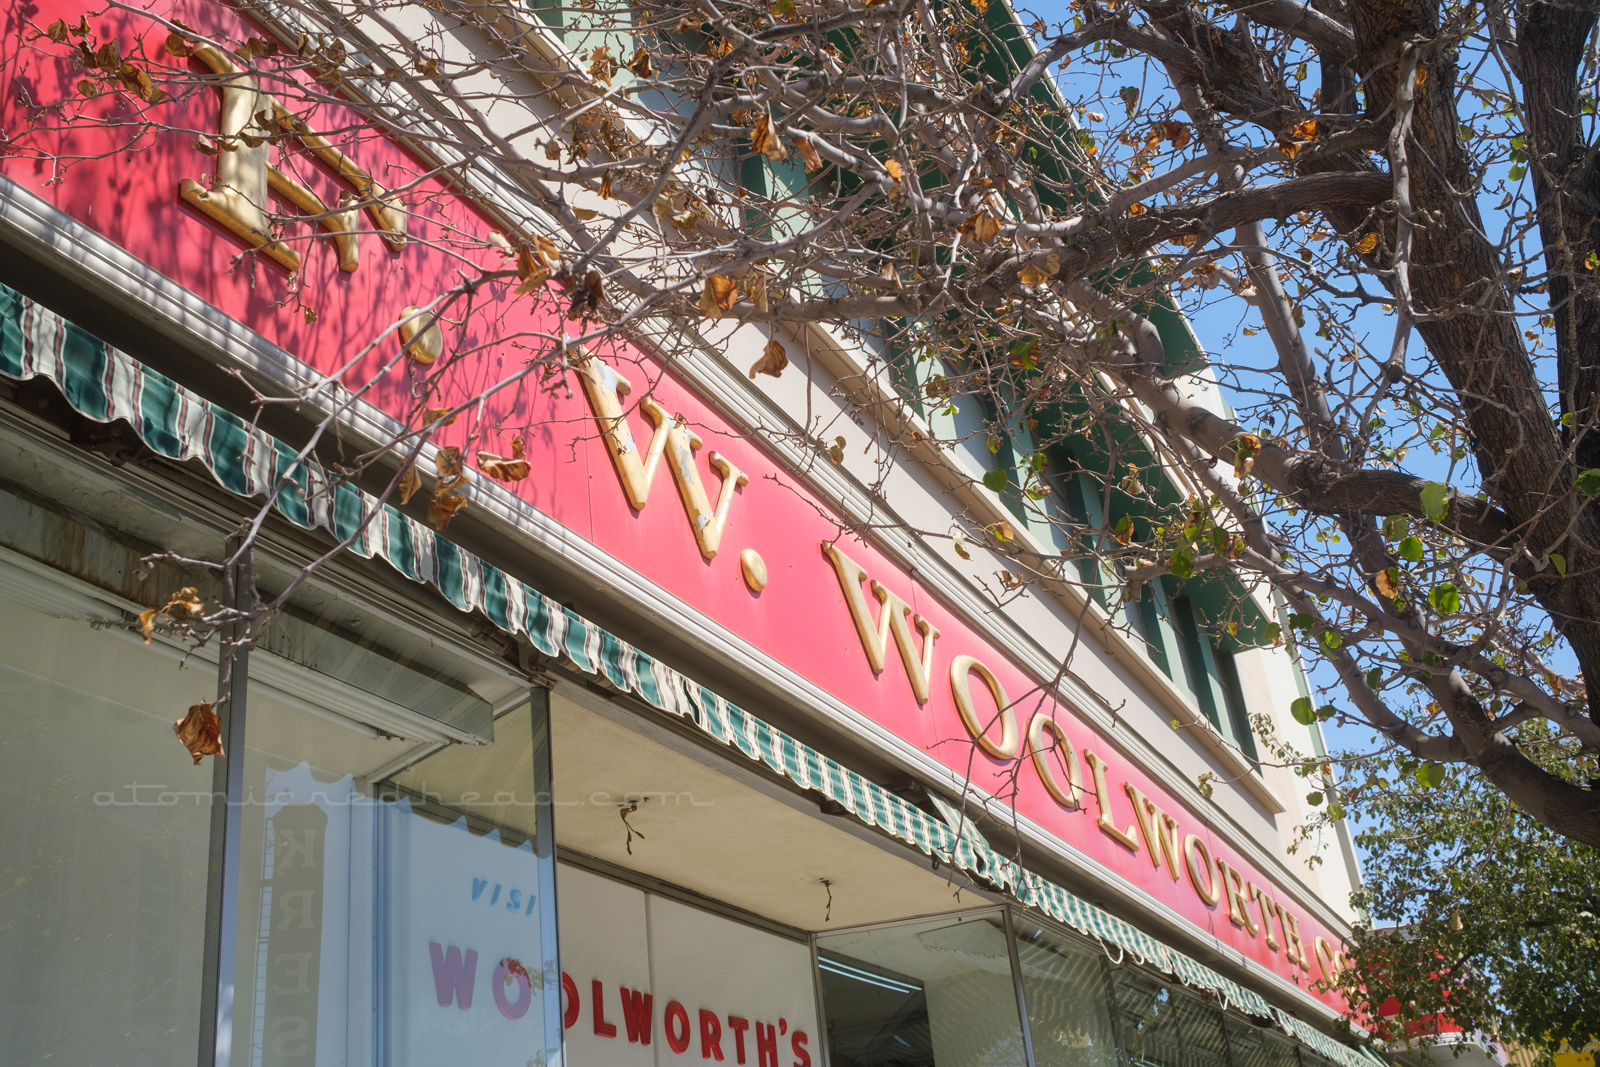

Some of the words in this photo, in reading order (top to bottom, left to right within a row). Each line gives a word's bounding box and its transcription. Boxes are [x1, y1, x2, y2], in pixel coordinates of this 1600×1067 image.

[563, 333, 768, 593] W.
[821, 539, 1311, 971] WOOLWORTH
[471, 877, 537, 918] VISI
